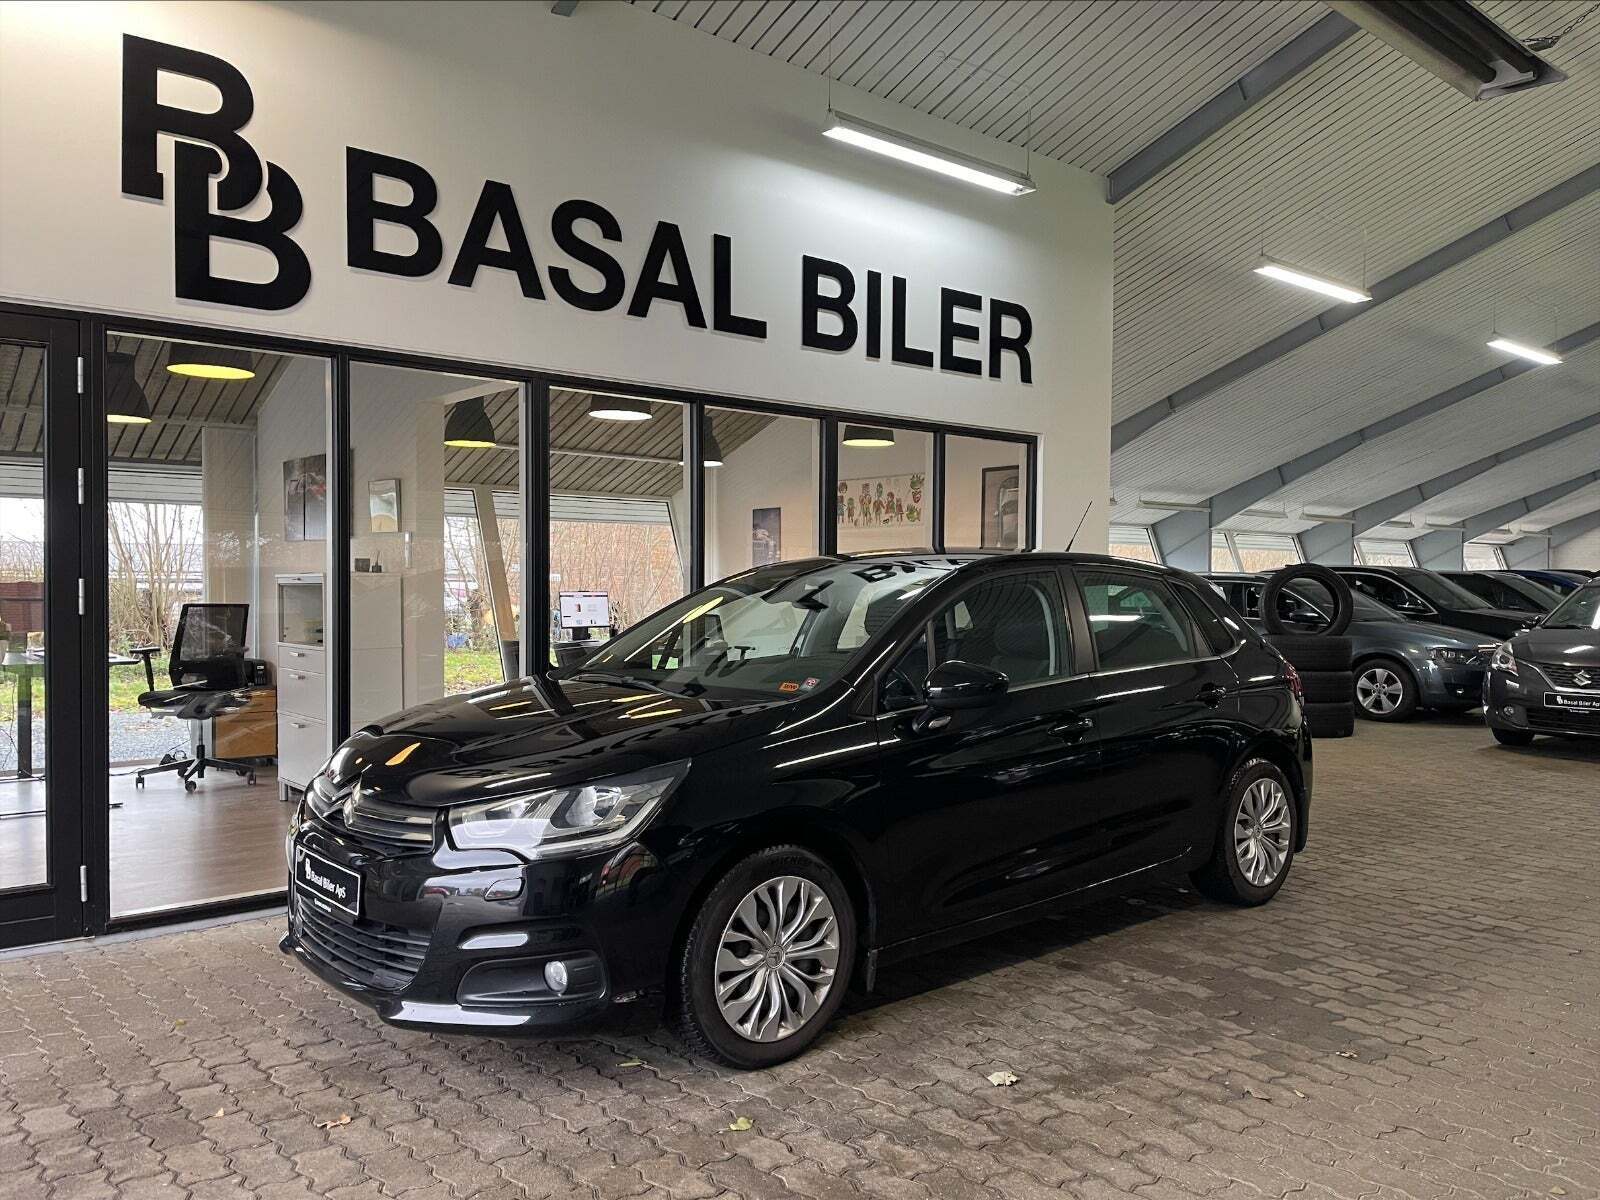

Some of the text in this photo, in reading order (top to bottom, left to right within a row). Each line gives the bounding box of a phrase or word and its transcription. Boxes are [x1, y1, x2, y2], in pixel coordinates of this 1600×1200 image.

[346, 146, 1034, 384] BASAL BILER
[335, 883, 347, 899] ApS
